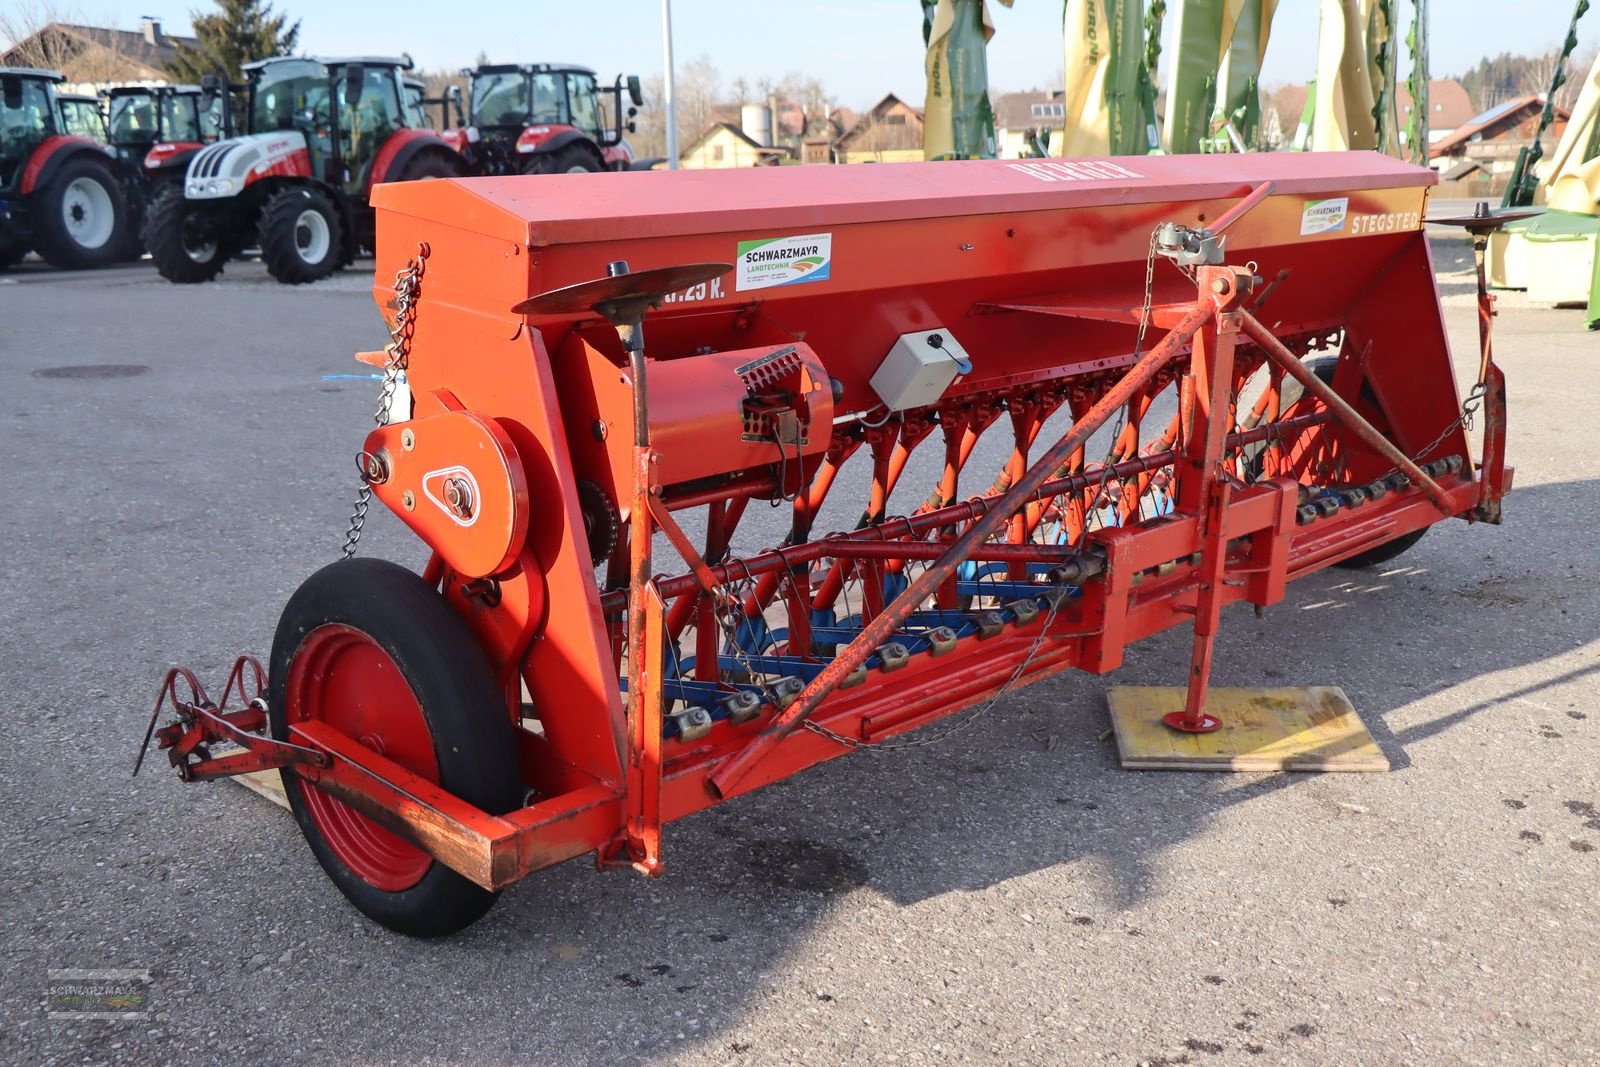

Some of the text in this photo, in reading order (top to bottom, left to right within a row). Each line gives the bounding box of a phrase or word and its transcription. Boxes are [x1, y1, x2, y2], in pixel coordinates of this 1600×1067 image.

[1087, 1, 1099, 65] KRONE
[1004, 160, 1145, 182] BERGER
[1351, 211, 1418, 234] STEGSTED
[745, 245, 819, 263] SCHWARZMAYR
[746, 261, 790, 274] LANDTECHNIK
